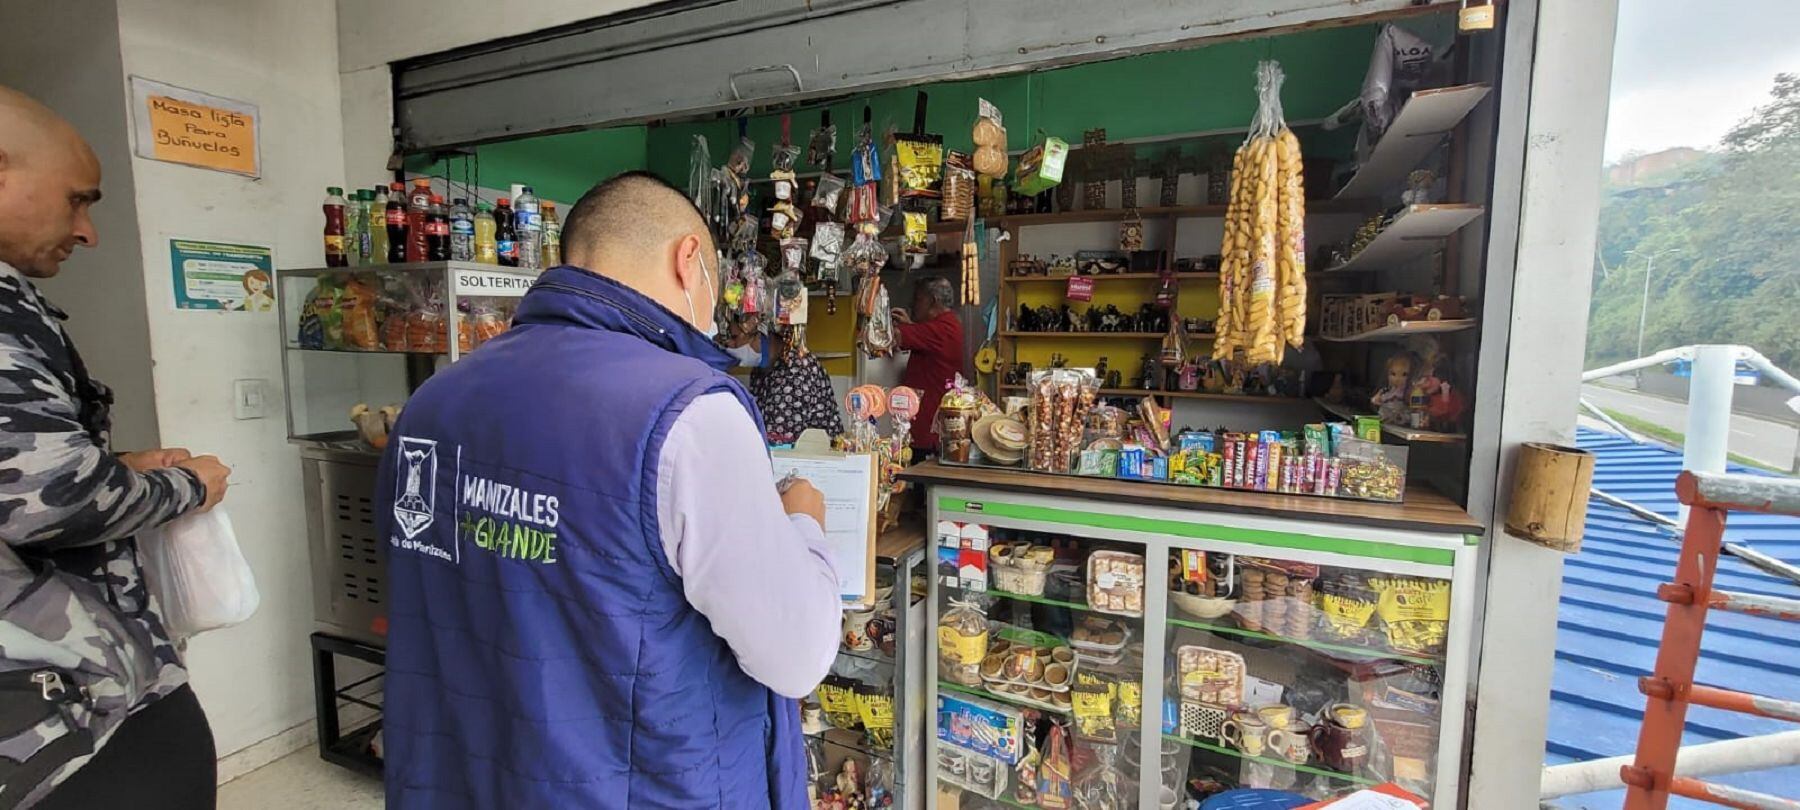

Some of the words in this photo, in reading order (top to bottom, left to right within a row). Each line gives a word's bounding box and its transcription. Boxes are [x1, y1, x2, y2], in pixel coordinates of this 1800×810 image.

[153, 99, 202, 119] Masa
[210, 109, 245, 128] lista
[157, 128, 241, 157] Buñuelos
[185, 122, 227, 139] Para
[463, 474, 559, 527] MANIZALES
